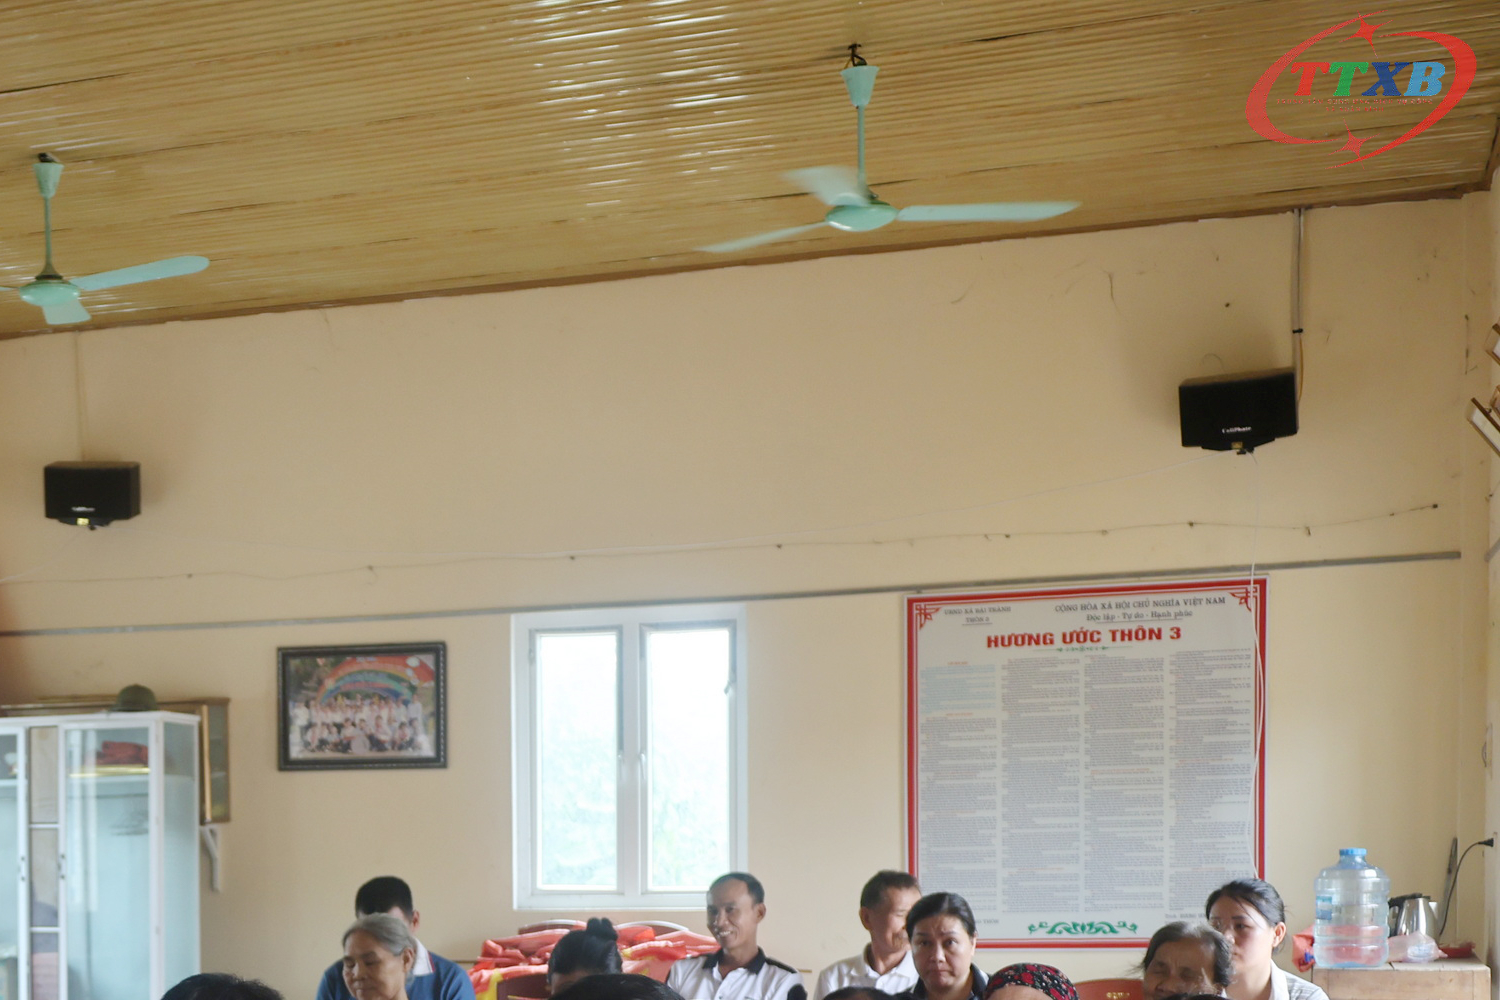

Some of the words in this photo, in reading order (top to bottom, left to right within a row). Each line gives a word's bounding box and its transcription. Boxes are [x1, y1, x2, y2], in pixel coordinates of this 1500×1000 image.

[1205, 596, 1226, 605] NAM
[986, 631, 1054, 649] HƯƠNG
[1061, 626, 1102, 645] ƯỚC
[1108, 625, 1162, 642] THÔN
[1169, 626, 1182, 640] 3
